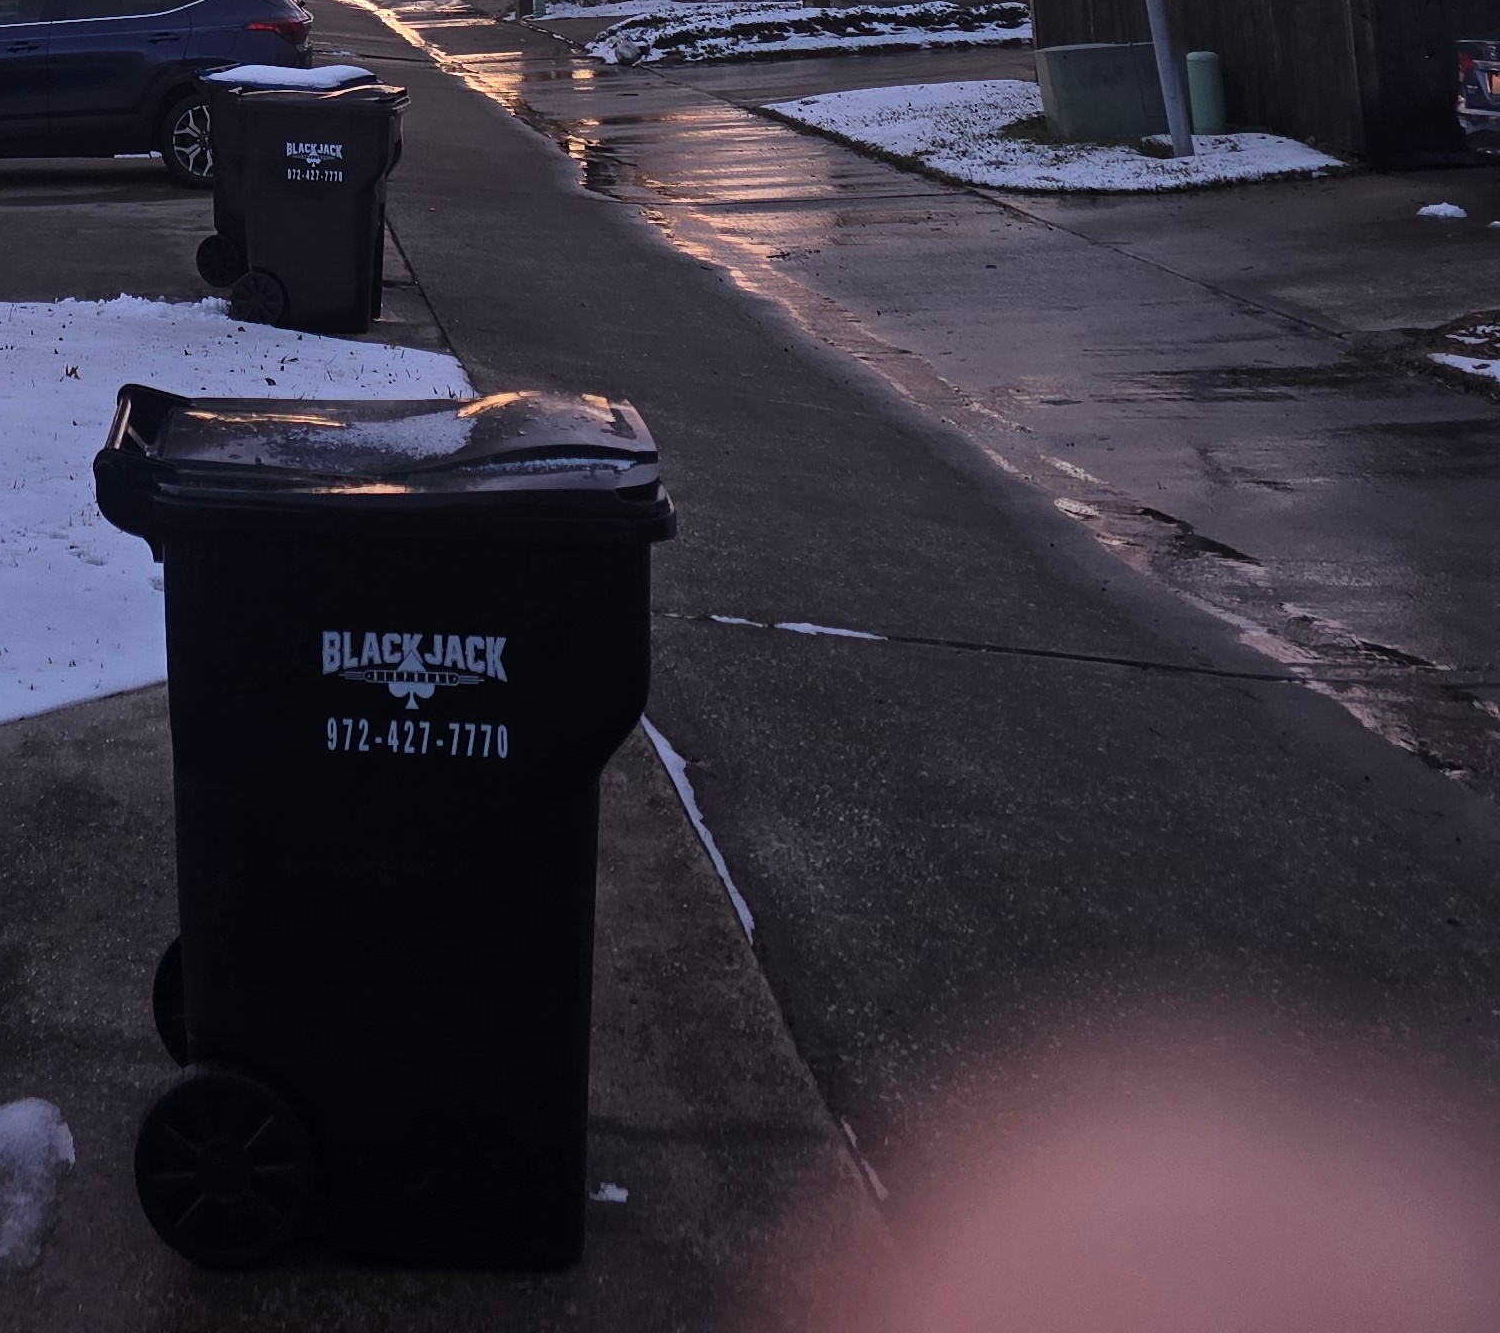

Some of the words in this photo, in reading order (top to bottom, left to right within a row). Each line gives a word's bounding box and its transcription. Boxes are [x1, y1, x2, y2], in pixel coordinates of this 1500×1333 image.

[286, 142, 342, 159] BLACKJACK
[322, 631, 508, 682] BLACKJACK
[327, 717, 508, 759] 972-427-7770
